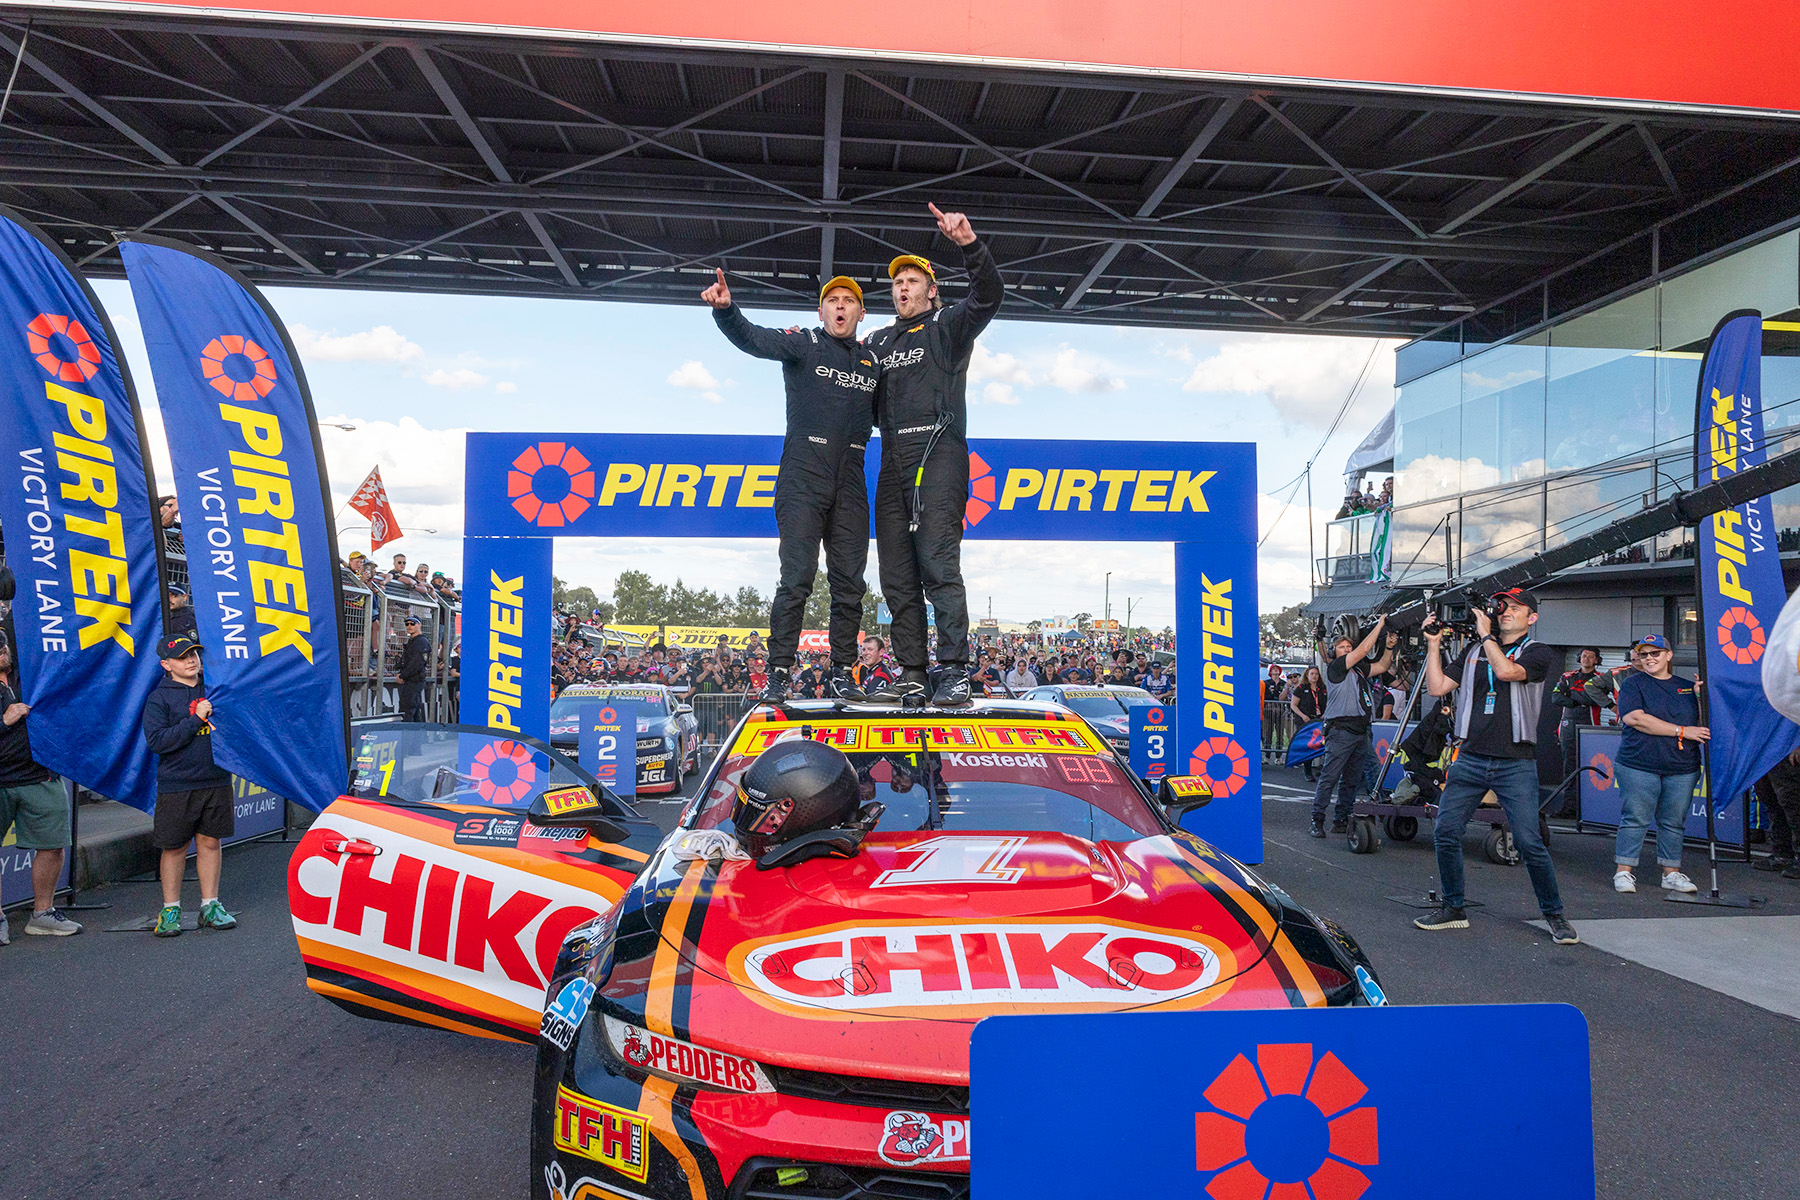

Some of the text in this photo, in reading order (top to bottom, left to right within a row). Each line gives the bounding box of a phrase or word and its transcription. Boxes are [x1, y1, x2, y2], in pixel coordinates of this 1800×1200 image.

[879, 347, 925, 366] rebus
[815, 365, 877, 389] erebus
[1740, 393, 1754, 454] LANE
[598, 463, 781, 507] PIRTE
[998, 468, 1218, 512] PIRTEK
[44, 380, 134, 657] PIRTEK
[219, 402, 313, 665] PIRTEK
[19, 447, 67, 652] VICTORY LANE
[197, 467, 249, 660] VICTORY LANE
[488, 569, 524, 733] PIRTEK
[1201, 572, 1235, 735] PIRTEK
[560, 689, 661, 697] NATIONAL STORAGE
[598, 735, 616, 760] 2
[846, 728, 858, 745] HIRE
[872, 727, 976, 744] TFH HIRE
[984, 727, 1078, 746] TFH
[1147, 735, 1165, 759] 3
[904, 753, 918, 767] 1
[948, 752, 1048, 768] Kostecki
[379, 759, 396, 797] 1
[1172, 778, 1206, 792] TFH
[234, 797, 277, 819] TORY LANE
[548, 790, 590, 810] TFH
[493, 827, 514, 835] 1000
[539, 826, 589, 842] Repco
[870, 835, 1028, 889] 1
[761, 931, 1204, 998] CHIKO
[541, 1011, 574, 1049] SIGNS
[650, 1035, 757, 1092] PEDDERS
[558, 1094, 642, 1166] TFH HIRE
